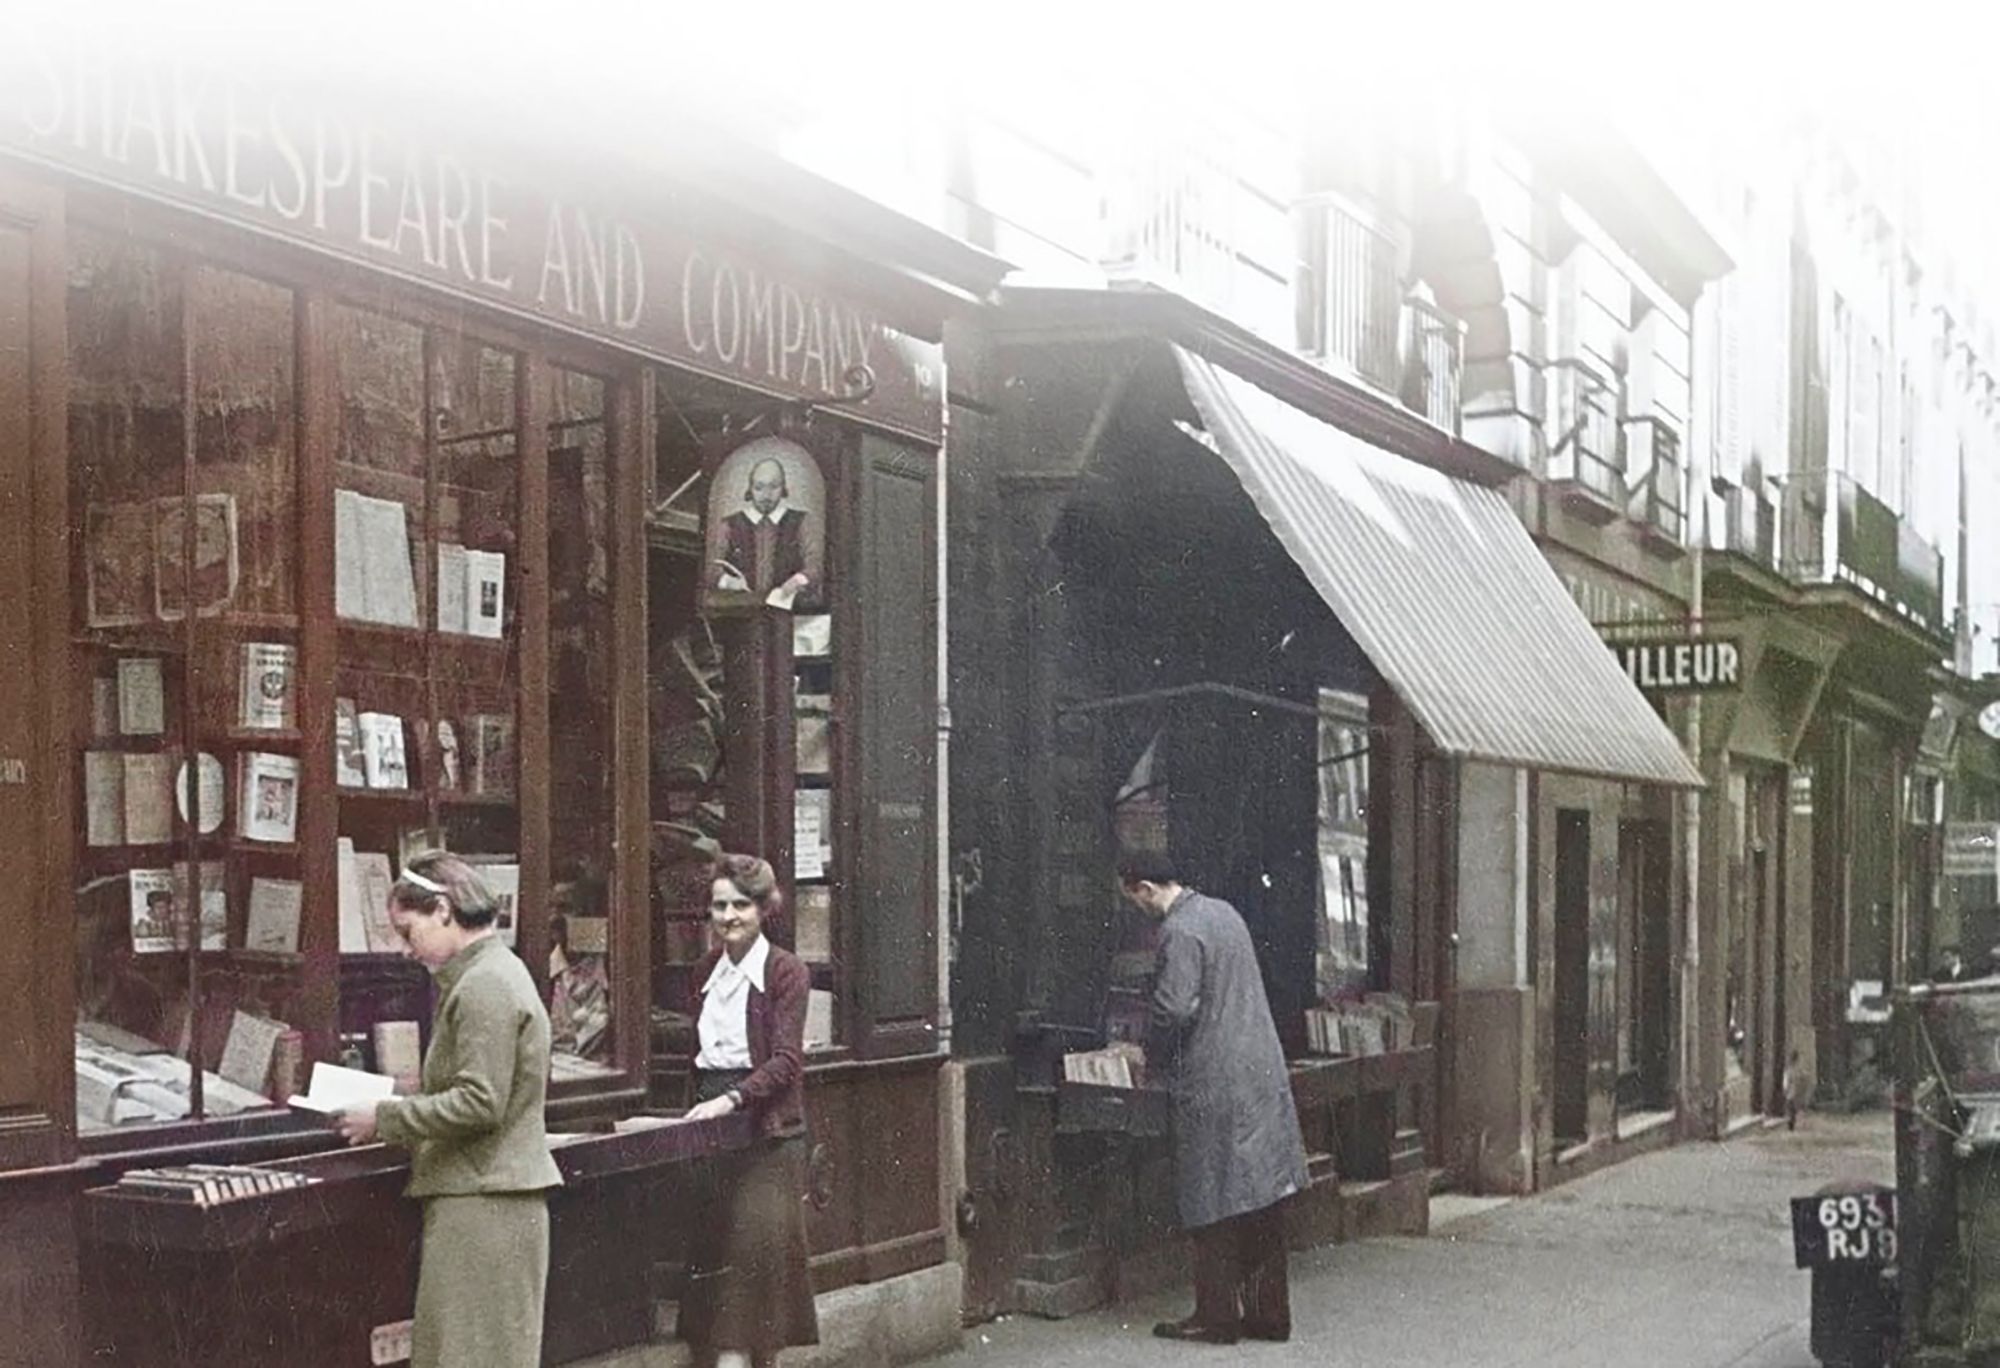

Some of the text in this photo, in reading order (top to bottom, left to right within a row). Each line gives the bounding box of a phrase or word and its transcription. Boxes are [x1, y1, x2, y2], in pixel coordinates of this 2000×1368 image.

[20, 30, 877, 405] SHAKESPEARE AND COMPANY
[1608, 642, 1739, 687] ILLEUR
